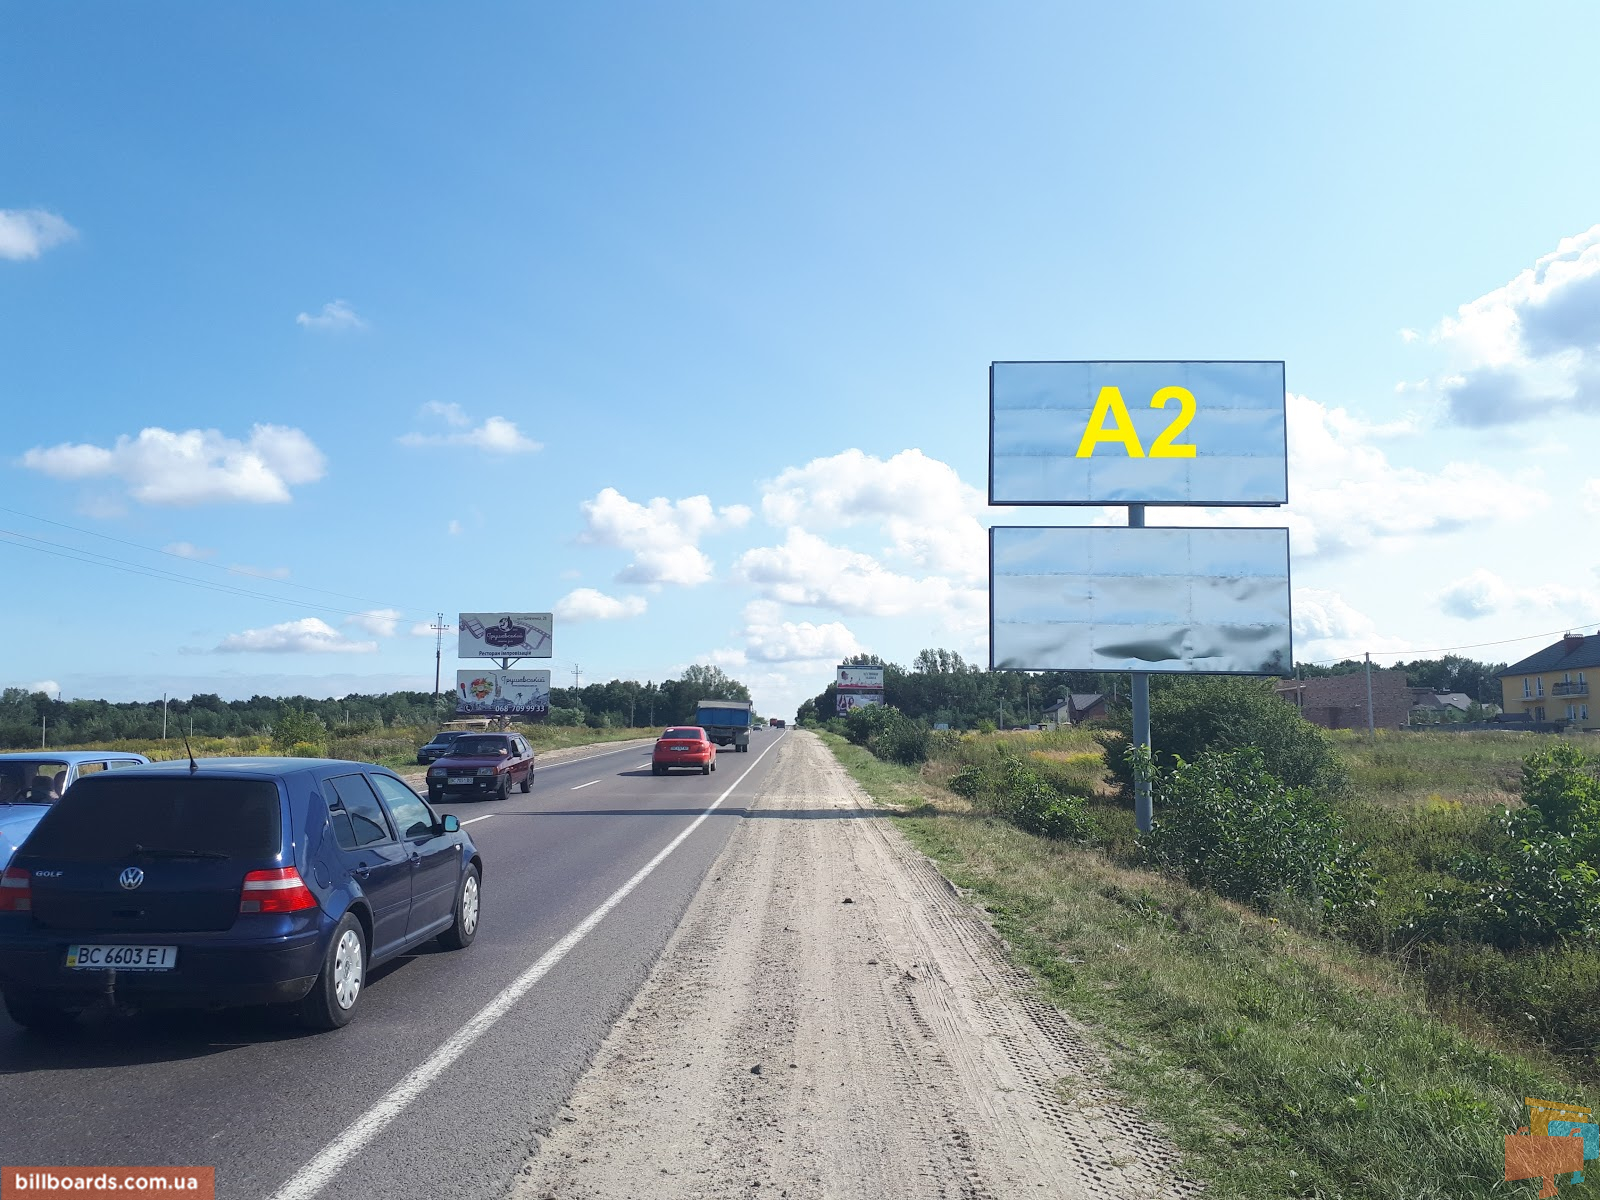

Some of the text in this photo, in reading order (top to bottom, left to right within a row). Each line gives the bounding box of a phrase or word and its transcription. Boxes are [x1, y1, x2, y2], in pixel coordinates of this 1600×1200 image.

[35, 870, 64, 878] GOLF
[77, 947, 167, 965] BC 6603 EI
